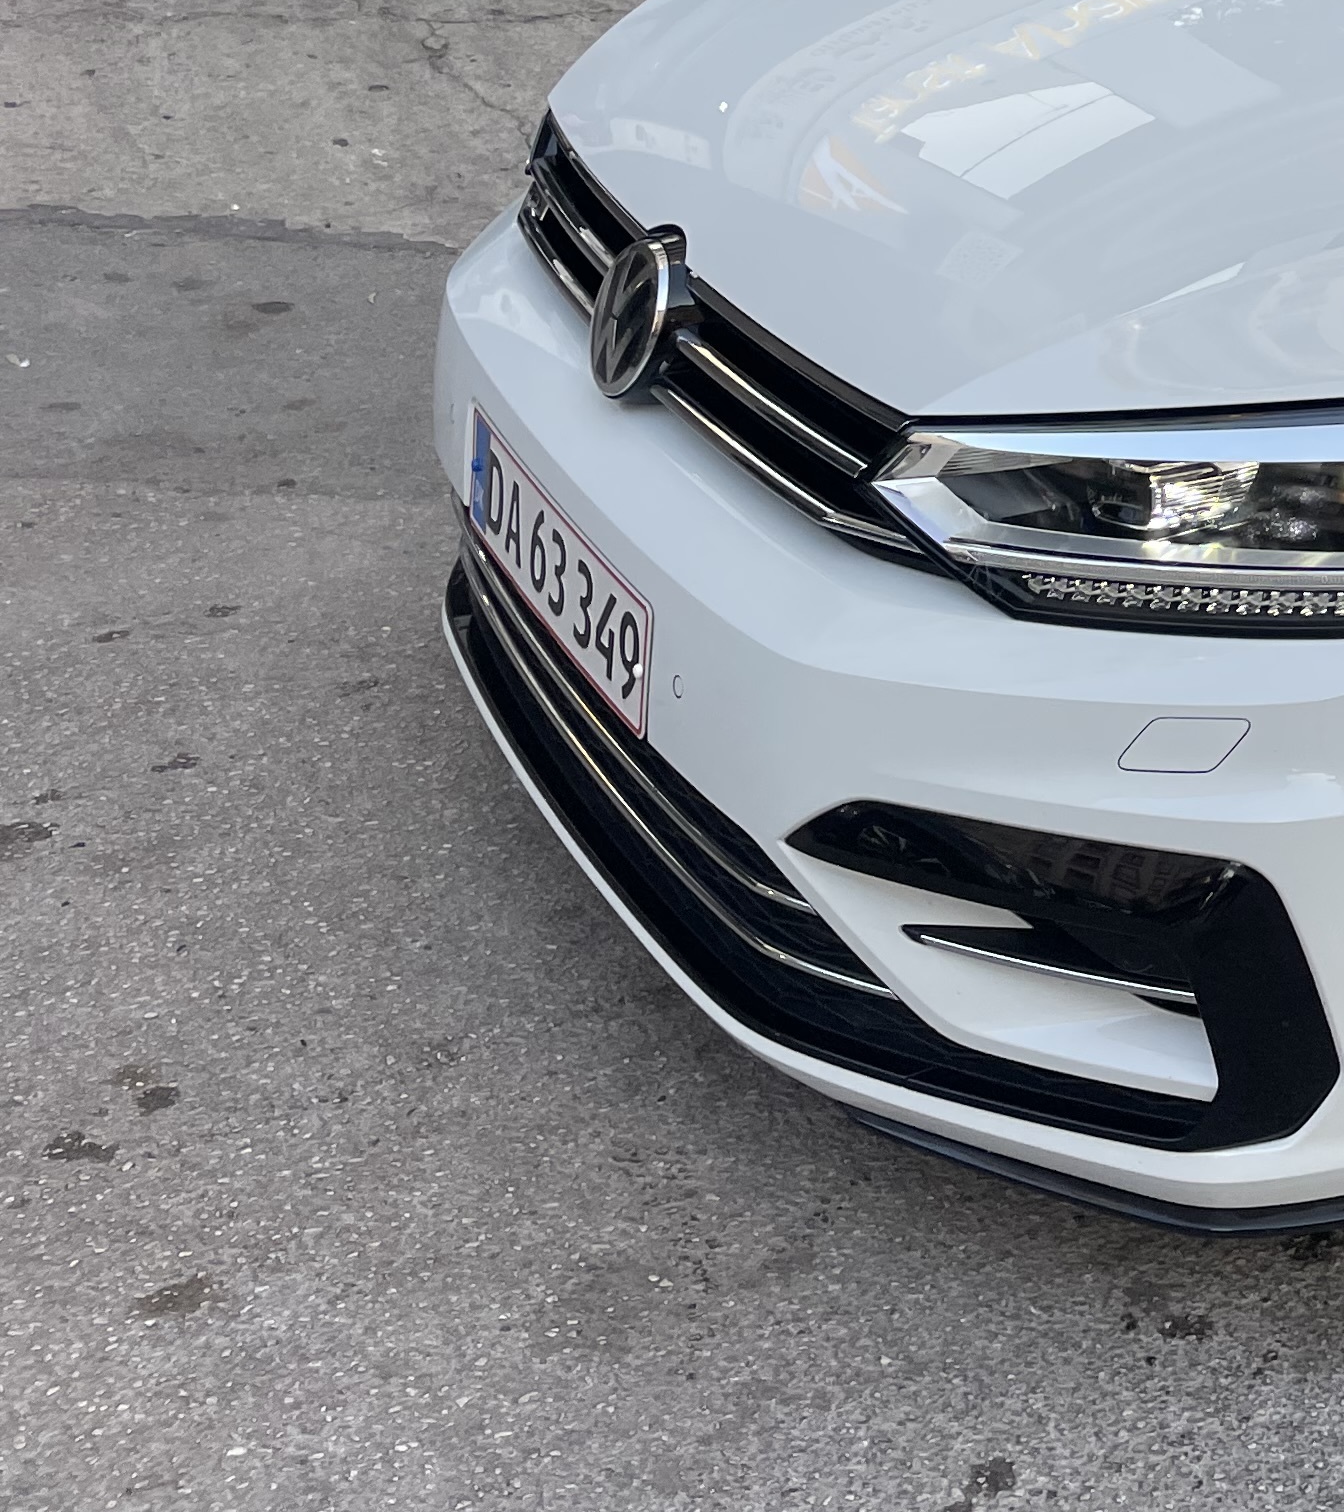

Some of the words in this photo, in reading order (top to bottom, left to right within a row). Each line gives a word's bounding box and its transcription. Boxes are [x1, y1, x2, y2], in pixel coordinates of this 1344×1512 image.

[486, 448, 522, 569] DA
[530, 509, 566, 617] 63
[573, 559, 641, 700] 349
